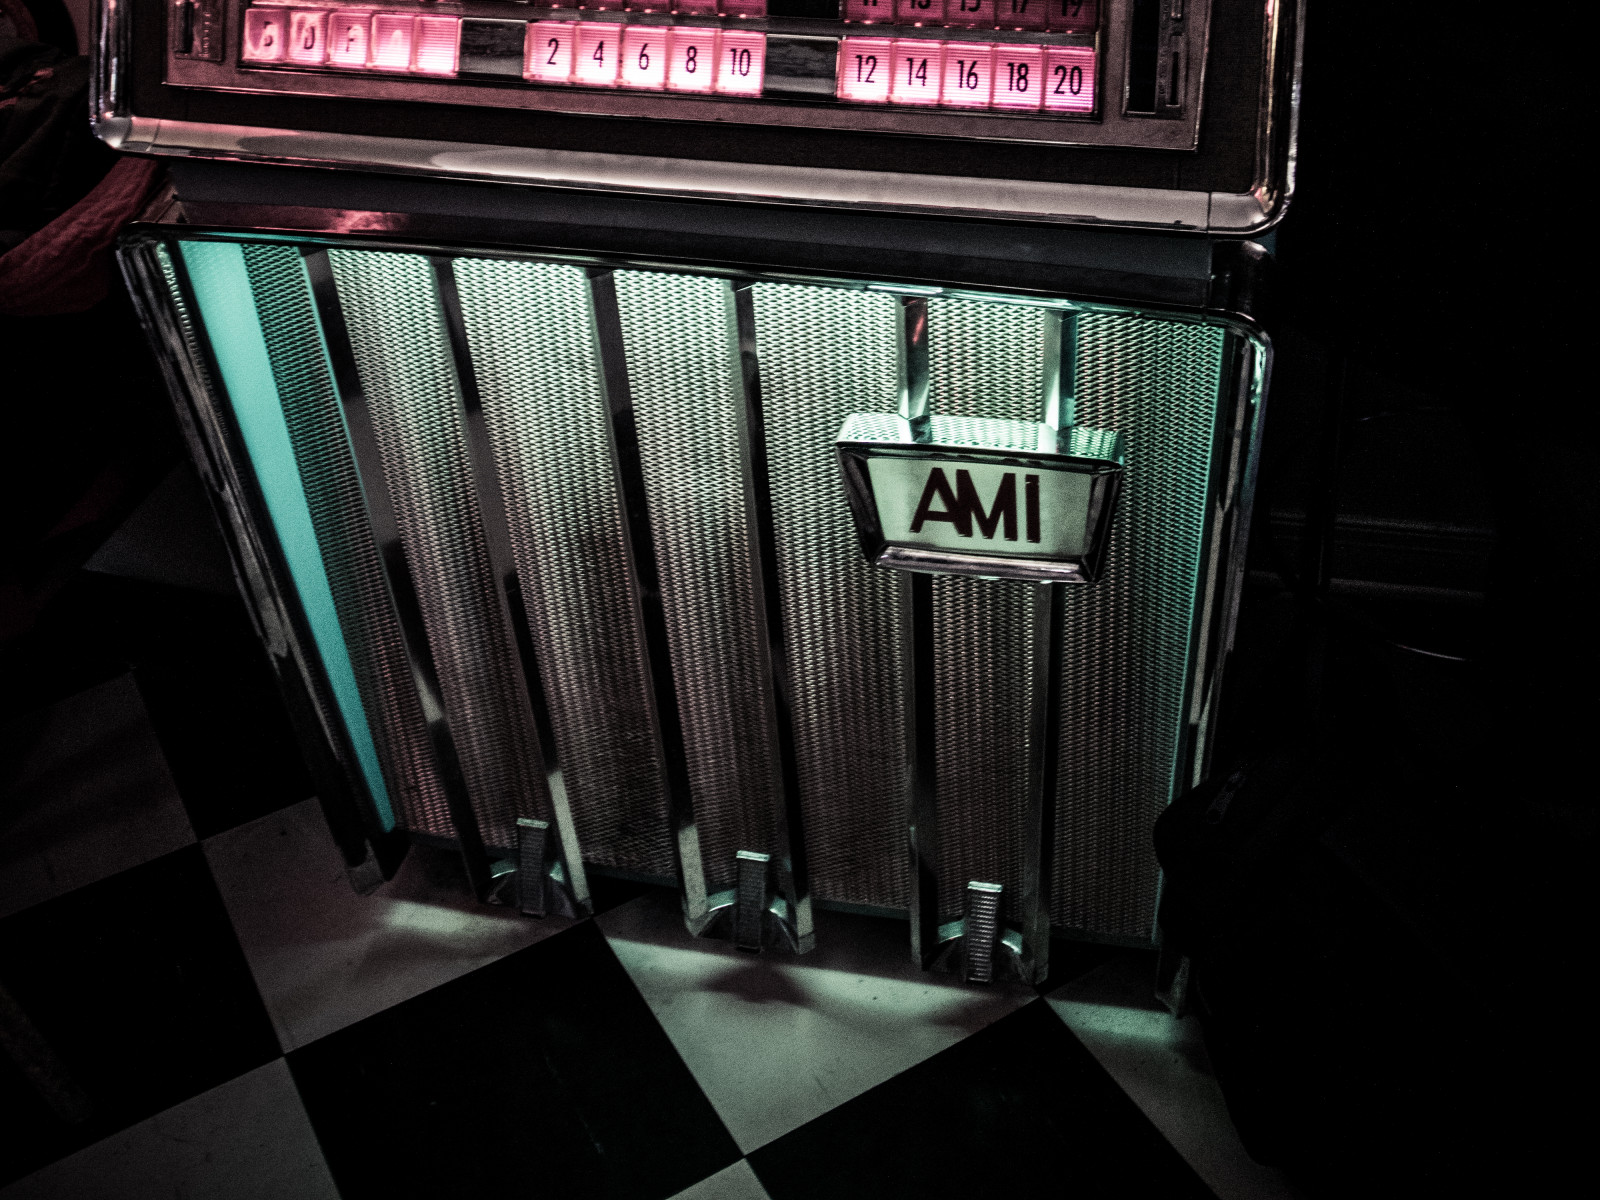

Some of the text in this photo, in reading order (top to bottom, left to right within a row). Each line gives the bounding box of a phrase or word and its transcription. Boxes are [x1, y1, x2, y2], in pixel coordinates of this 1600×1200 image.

[547, 38, 751, 76] 2 4 6 8 10
[855, 54, 1083, 96] 12 14 16 18 20
